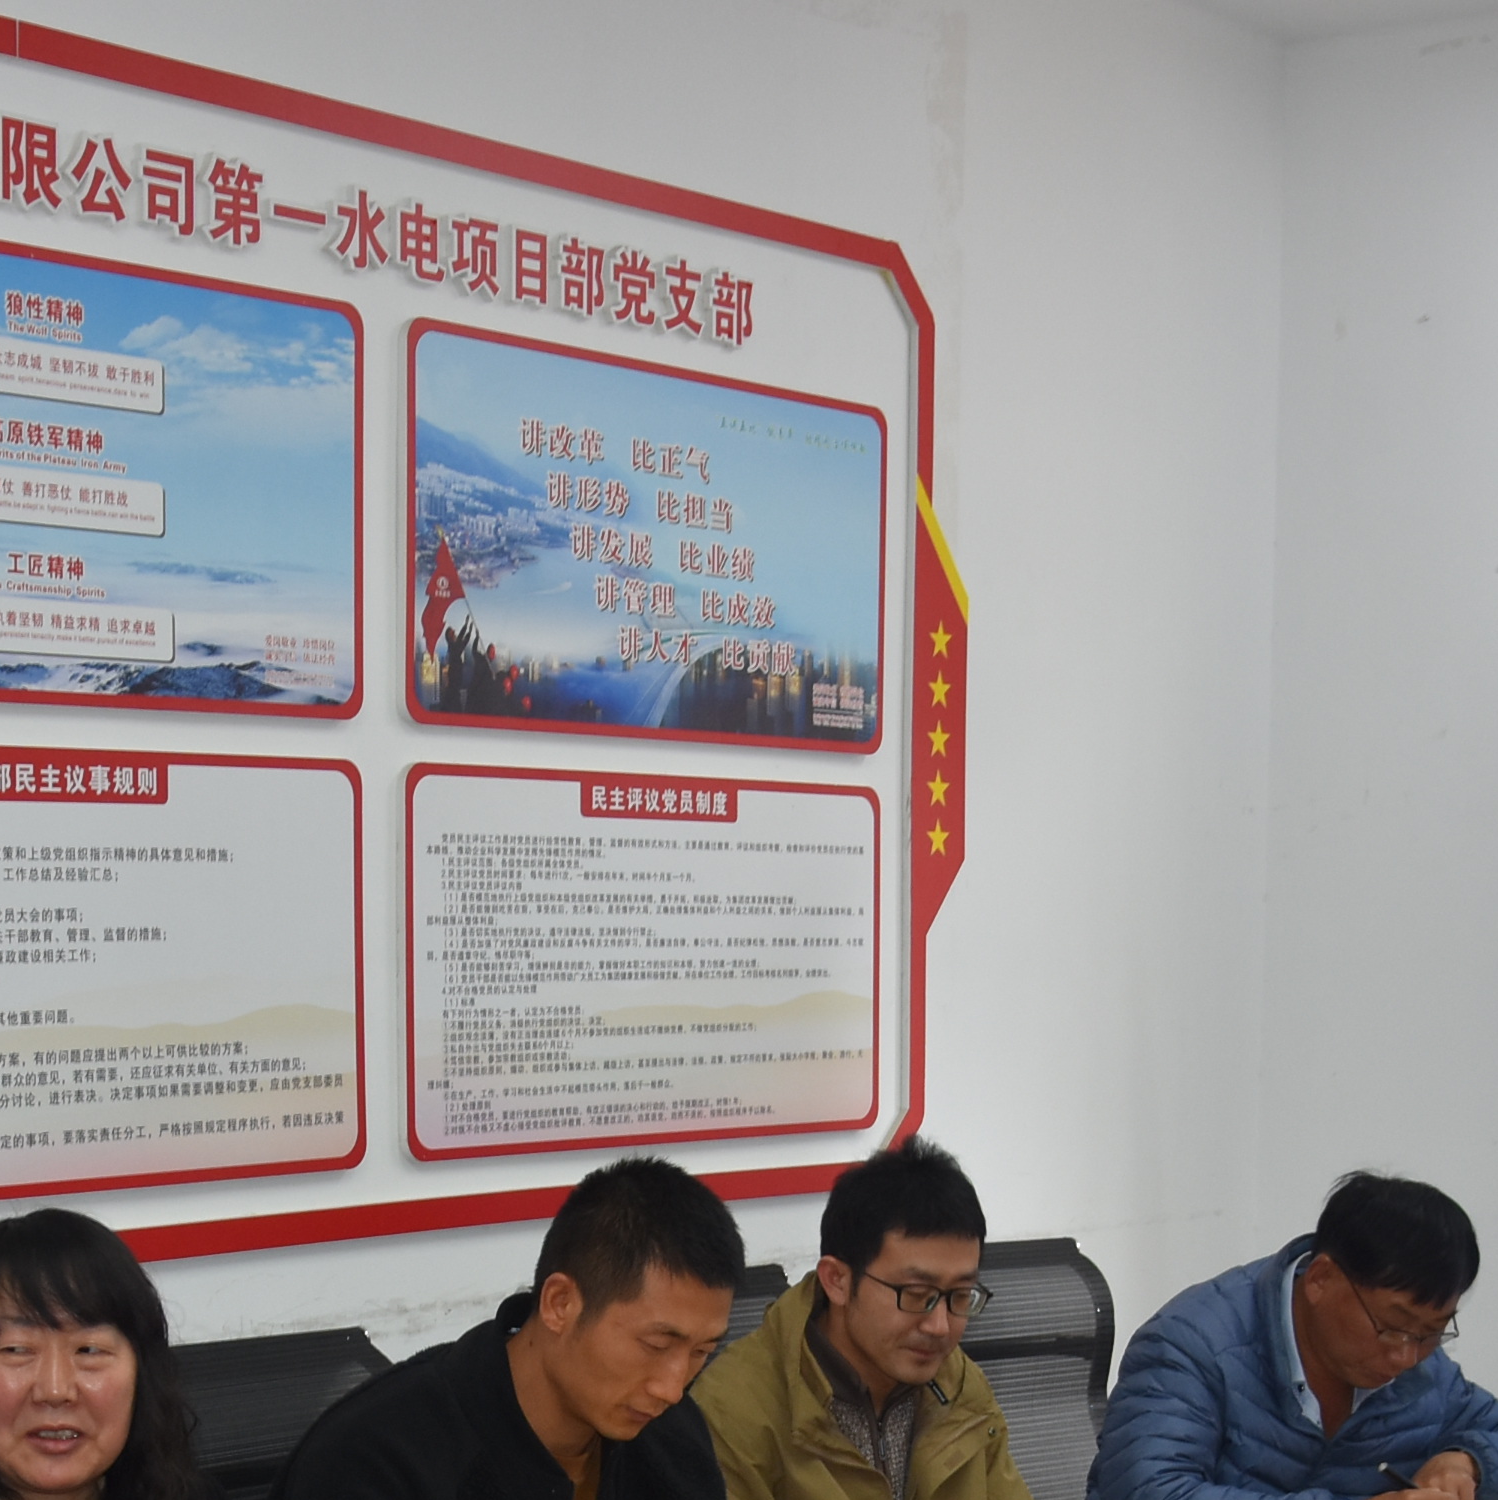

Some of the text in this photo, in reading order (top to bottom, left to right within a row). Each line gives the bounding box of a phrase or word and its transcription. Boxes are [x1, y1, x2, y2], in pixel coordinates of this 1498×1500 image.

[5, 289, 85, 326] 狼性精神
[7, 321, 82, 342] The Wolf Spirits
[49, 356, 98, 378] 坚韧不拔
[106, 364, 155, 386] 敢于胜利
[16, 450, 25, 461] of
[27, 451, 41, 463] the
[44, 454, 77, 468] Plateau
[81, 458, 98, 470] Iron
[102, 459, 126, 475] Army
[519, 418, 711, 484] 讲改革 比正气
[22, 481, 72, 502] 善打恶仗
[546, 471, 734, 533] 讲形势 比担当
[7, 552, 85, 582] 工匠精神
[570, 523, 755, 582] 讲发展 比业绩
[6, 580, 72, 597] Craftsmanship
[76, 586, 106, 598] Spirits
[594, 574, 776, 629] 讲管理 比成效
[51, 613, 100, 631] 精益求精
[107, 617, 156, 636] 追求卓越
[617, 624, 796, 675] 讲人才 比贡献
[591, 785, 728, 816] 民主评议党员制度
